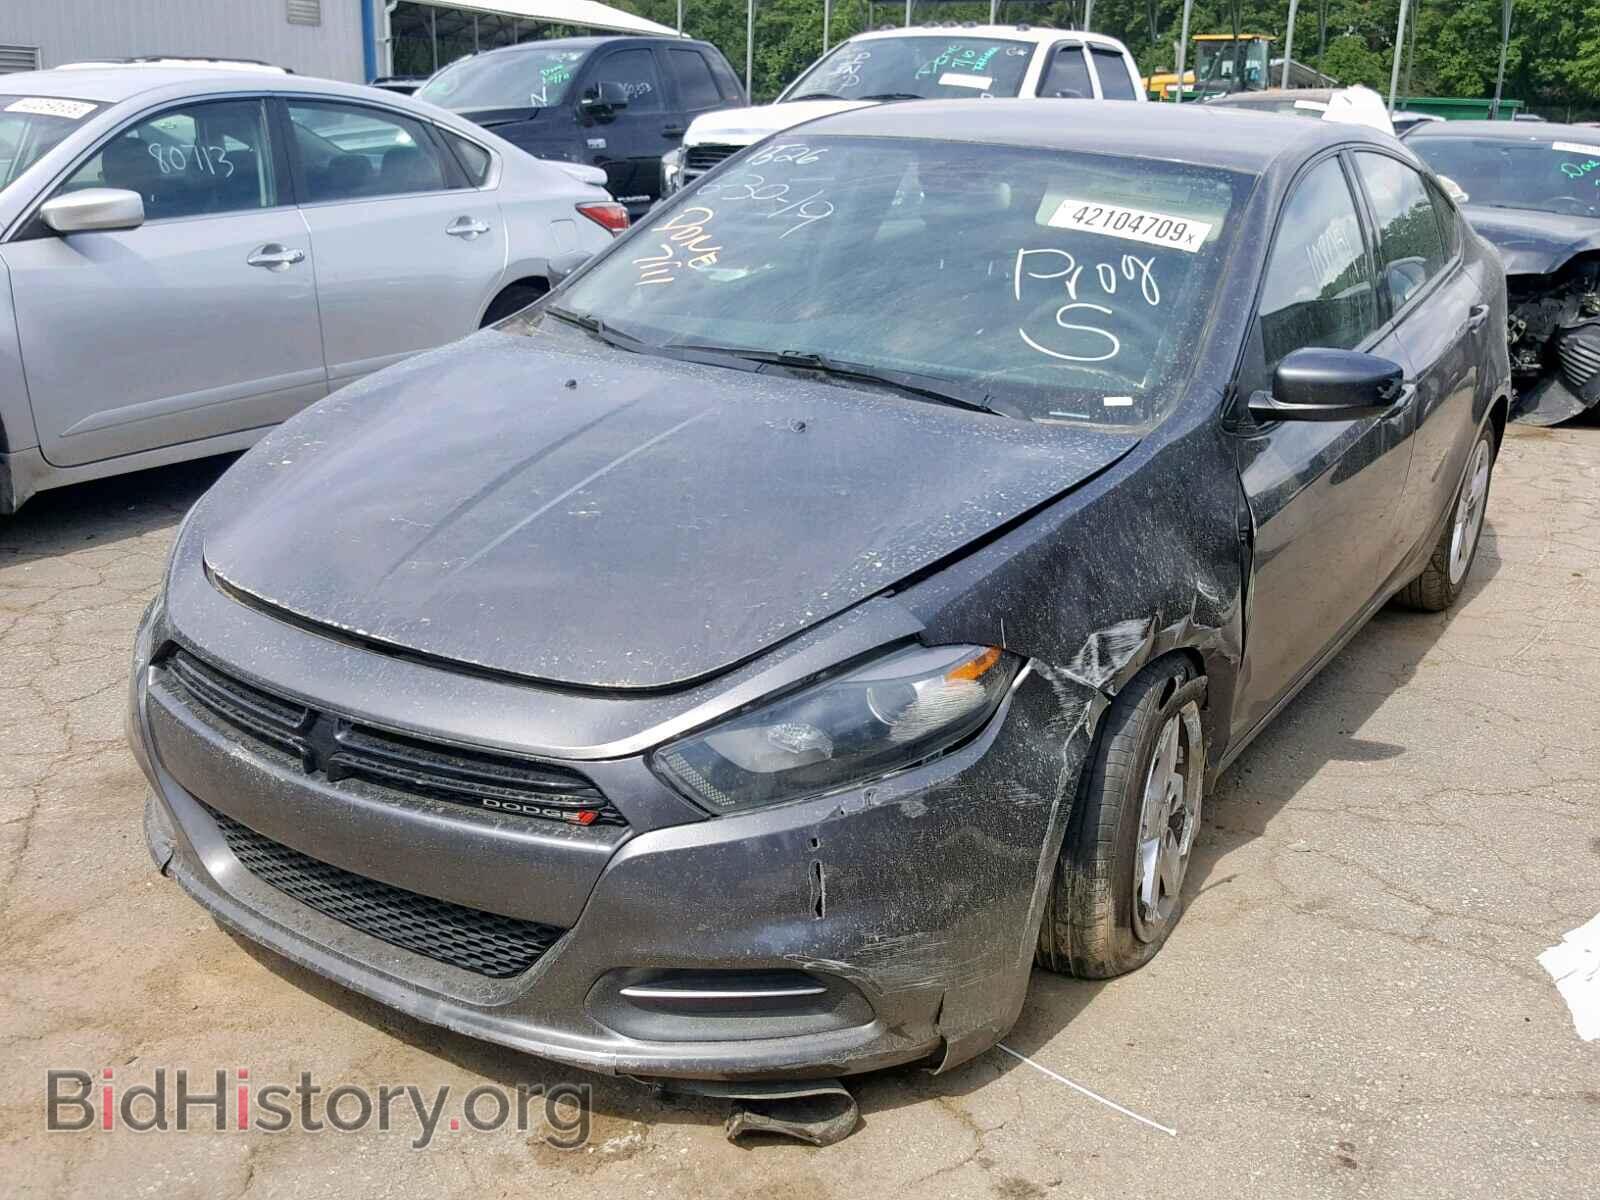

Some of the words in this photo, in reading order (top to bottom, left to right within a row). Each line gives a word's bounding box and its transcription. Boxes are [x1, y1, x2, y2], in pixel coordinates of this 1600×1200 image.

[148, 143, 234, 178] 80713
[1015, 248, 1160, 305] Prog
[1019, 303, 1120, 361] S
[483, 799, 580, 821] DODGE
